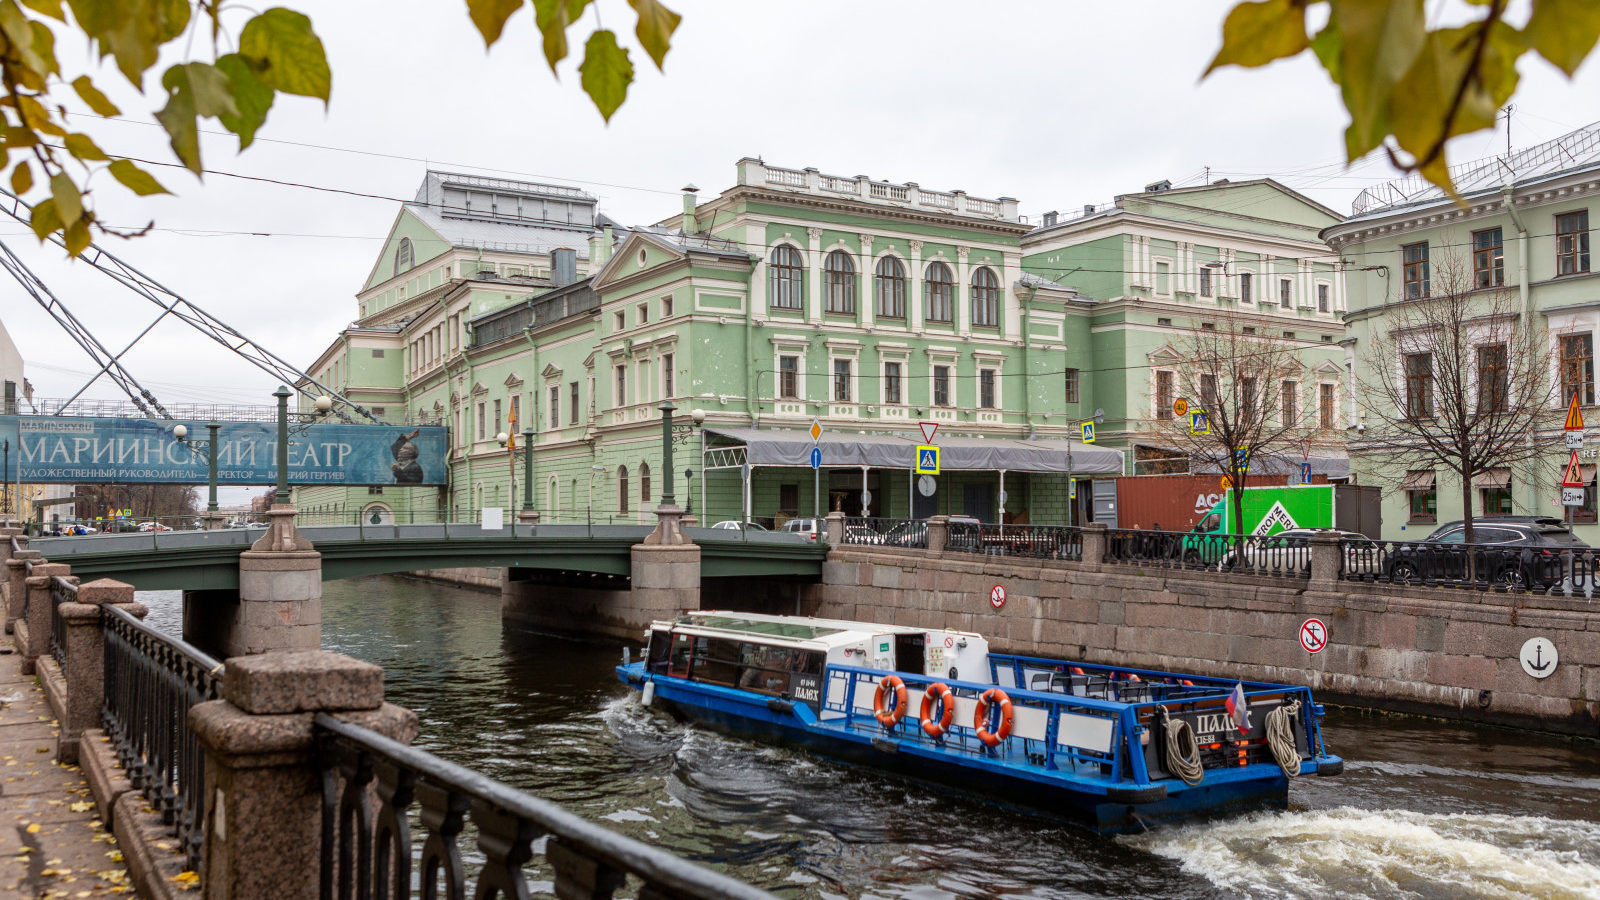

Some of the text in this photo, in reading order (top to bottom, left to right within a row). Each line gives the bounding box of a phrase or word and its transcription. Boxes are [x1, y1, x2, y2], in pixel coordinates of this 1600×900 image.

[1176, 403, 1185, 411] 40
[21, 422, 92, 432] MARIINSKY.RU
[20, 434, 353, 467] МАРИИНСКИЙ ТЕАТР
[268, 470, 308, 480] ВАЕРИЙ
[309, 471, 345, 480] ГЕРГИЕВ
